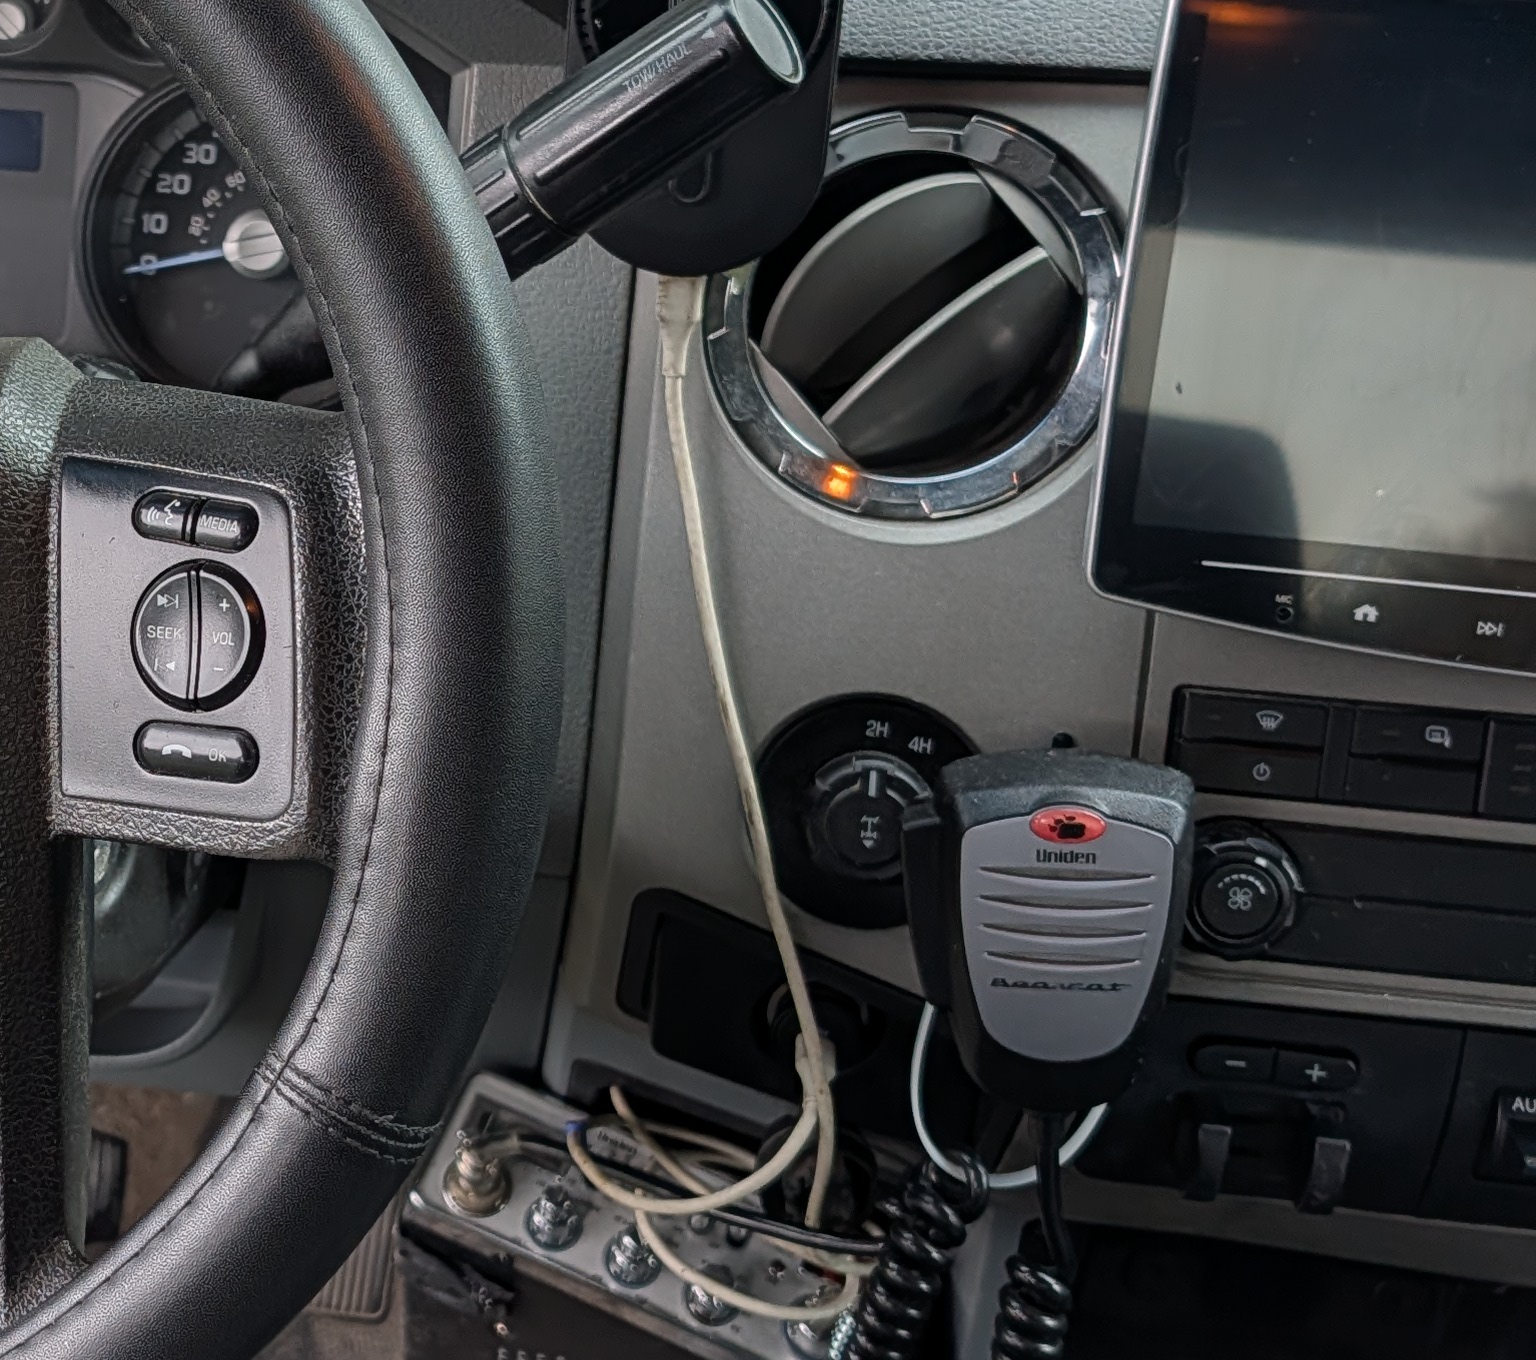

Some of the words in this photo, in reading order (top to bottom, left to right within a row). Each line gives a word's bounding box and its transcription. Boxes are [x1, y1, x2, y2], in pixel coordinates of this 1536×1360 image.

[182, 141, 218, 166] 30
[156, 173, 192, 196] 20
[141, 212, 169, 235] 10
[199, 514, 239, 533] MEDIA
[147, 624, 183, 640] SEEK
[212, 630, 235, 646] VOL
[865, 719, 889, 738] 2H
[907, 735, 933, 755] 4H
[208, 747, 227, 763] OK
[1035, 848, 1097, 865] Uniden
